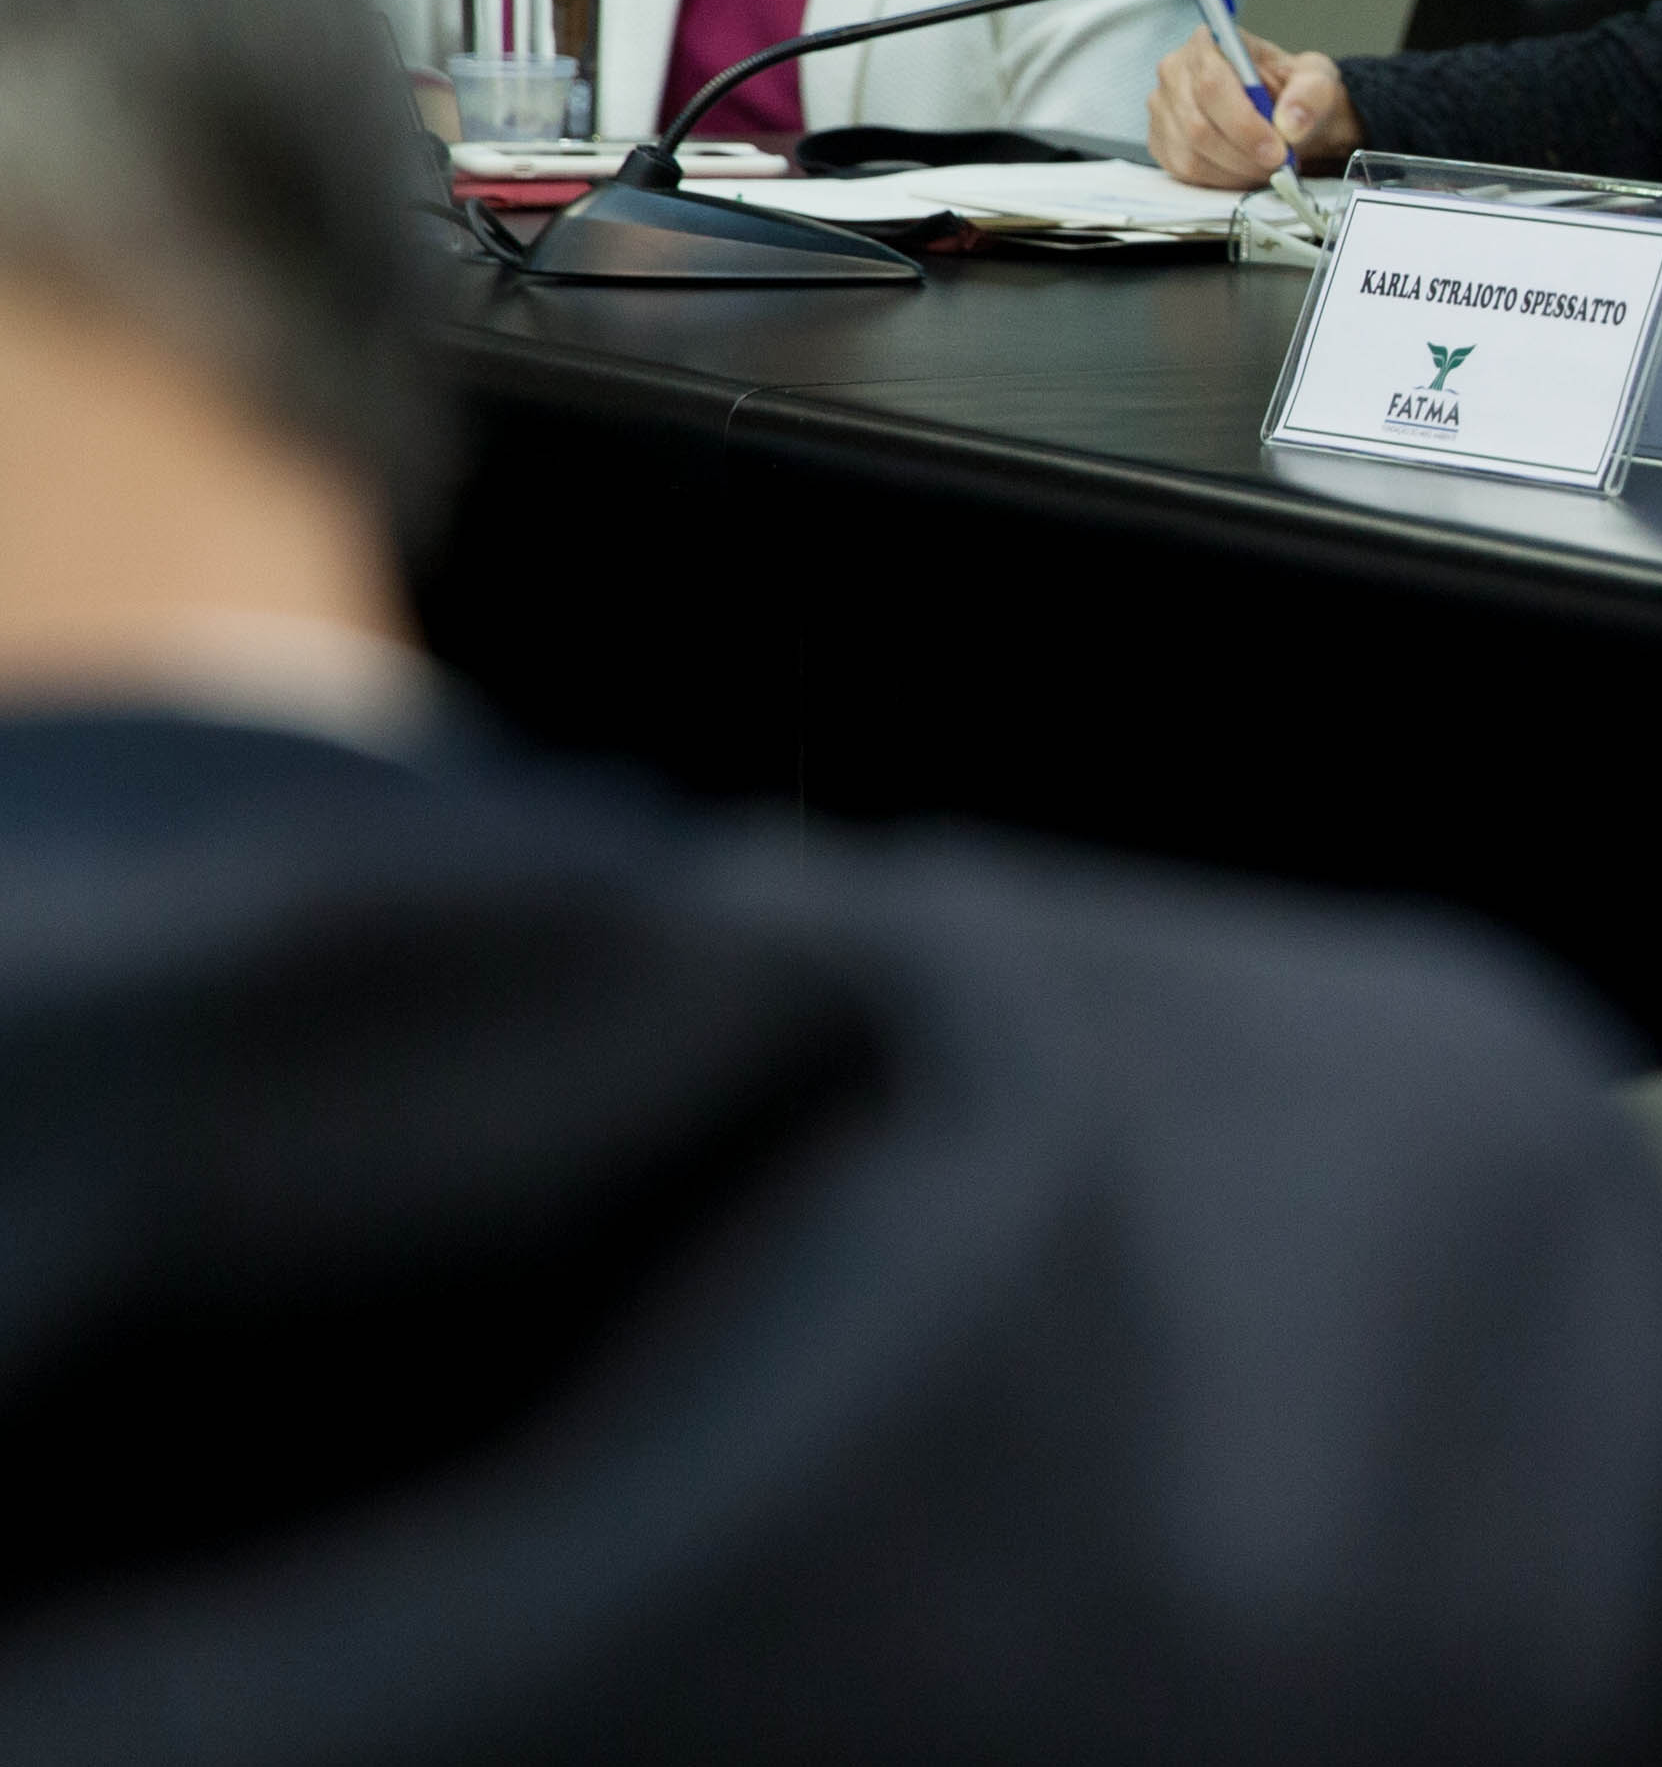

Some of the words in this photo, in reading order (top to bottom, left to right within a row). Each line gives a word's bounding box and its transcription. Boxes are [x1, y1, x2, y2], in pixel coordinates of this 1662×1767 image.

[1359, 269, 1421, 300] KARLA
[1425, 277, 1518, 312] STRAIOTO
[1519, 289, 1627, 326] SPESSATTO
[1386, 393, 1459, 426] FATMA
